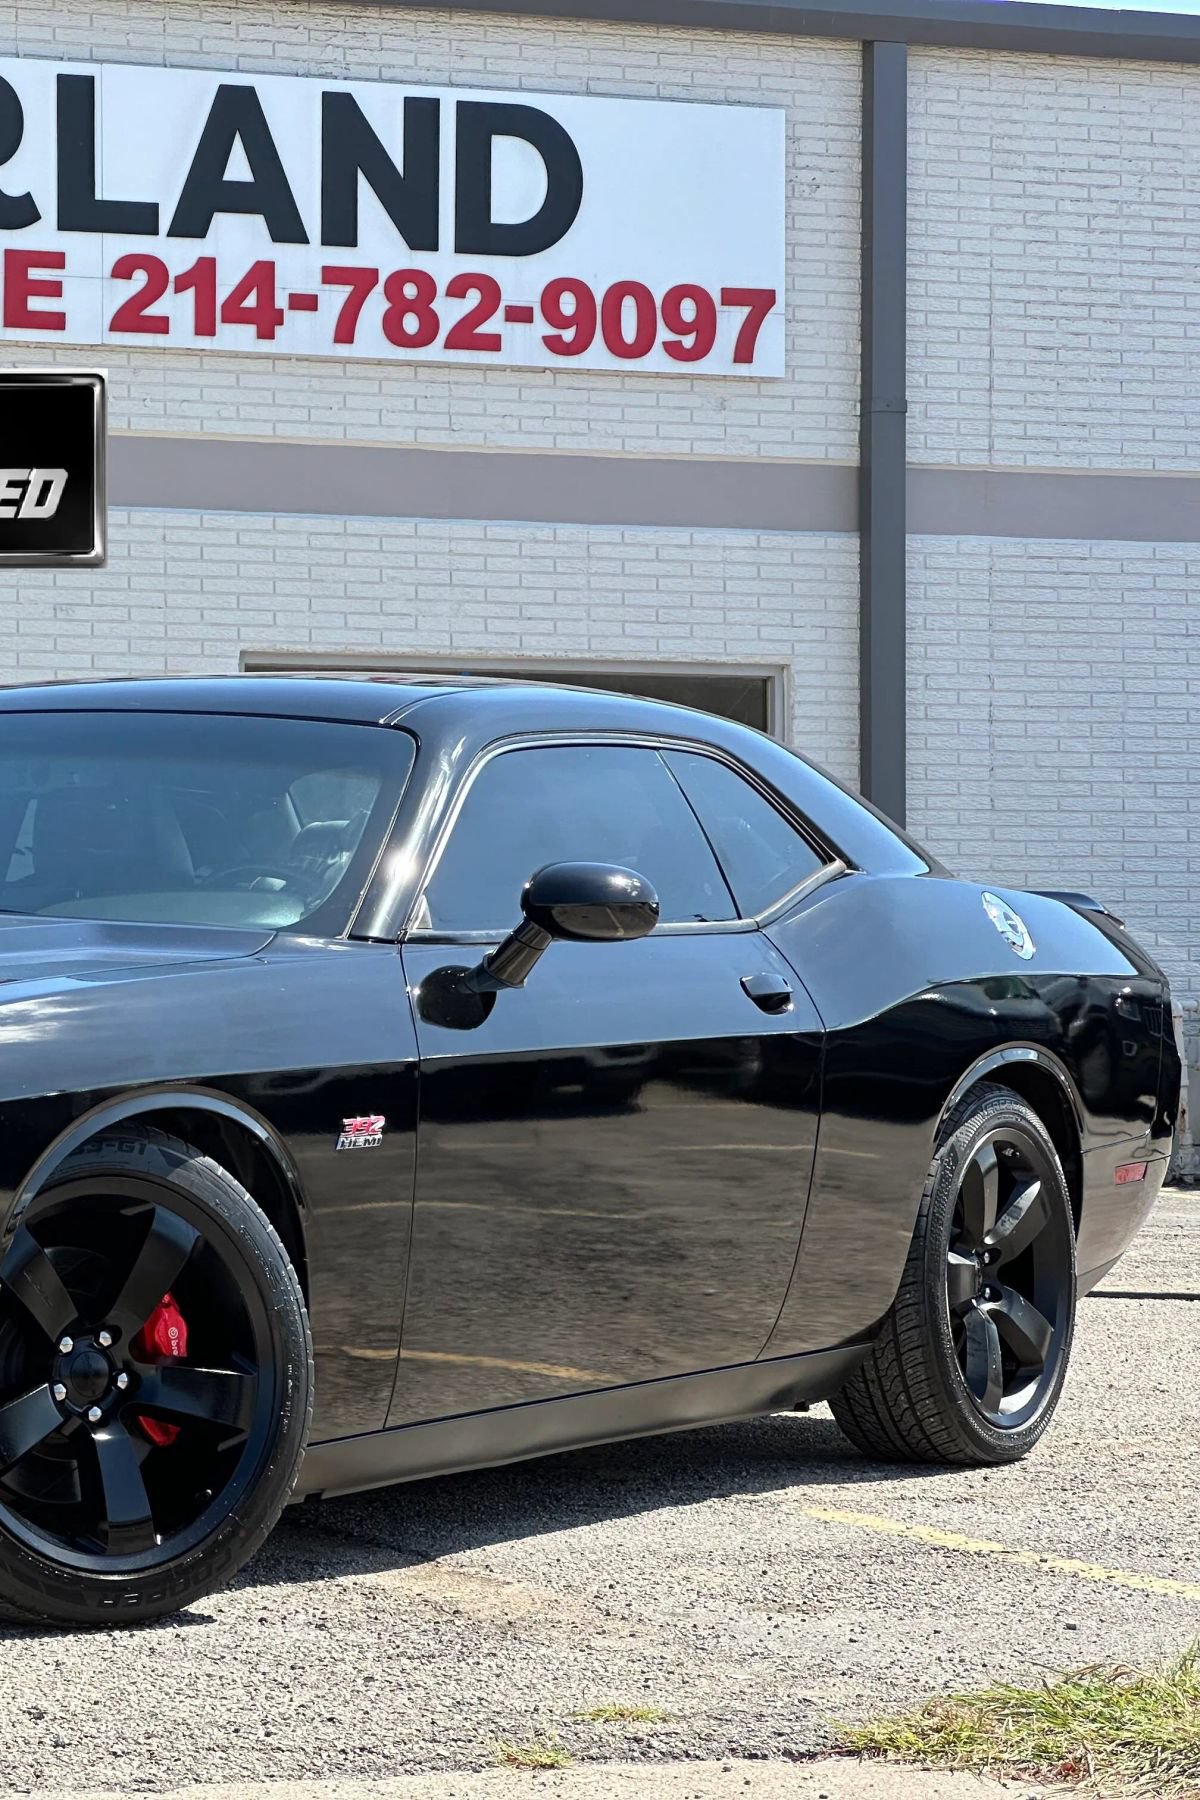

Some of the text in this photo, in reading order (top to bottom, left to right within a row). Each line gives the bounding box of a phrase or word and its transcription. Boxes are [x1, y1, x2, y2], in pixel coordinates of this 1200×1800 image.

[108, 253, 777, 364] 214-782-9097
[341, 1115, 386, 1137] 392
[336, 1134, 383, 1150] HEMI
